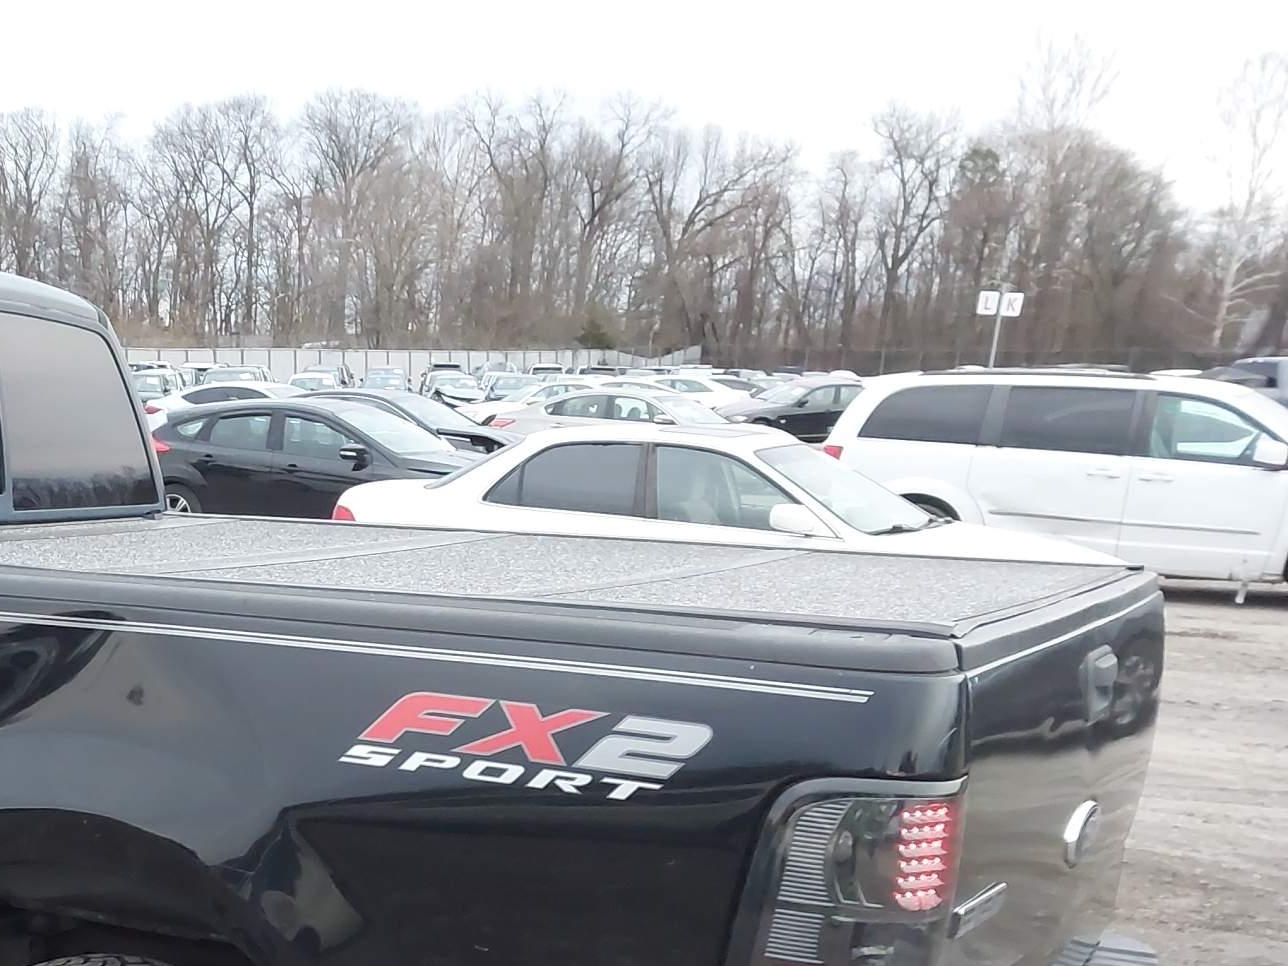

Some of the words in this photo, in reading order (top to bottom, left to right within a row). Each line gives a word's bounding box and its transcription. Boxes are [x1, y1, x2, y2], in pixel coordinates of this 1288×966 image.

[983, 294, 994, 311] L
[1005, 296, 1019, 312] K
[357, 691, 713, 780] FX2
[338, 744, 665, 800] SPORT
